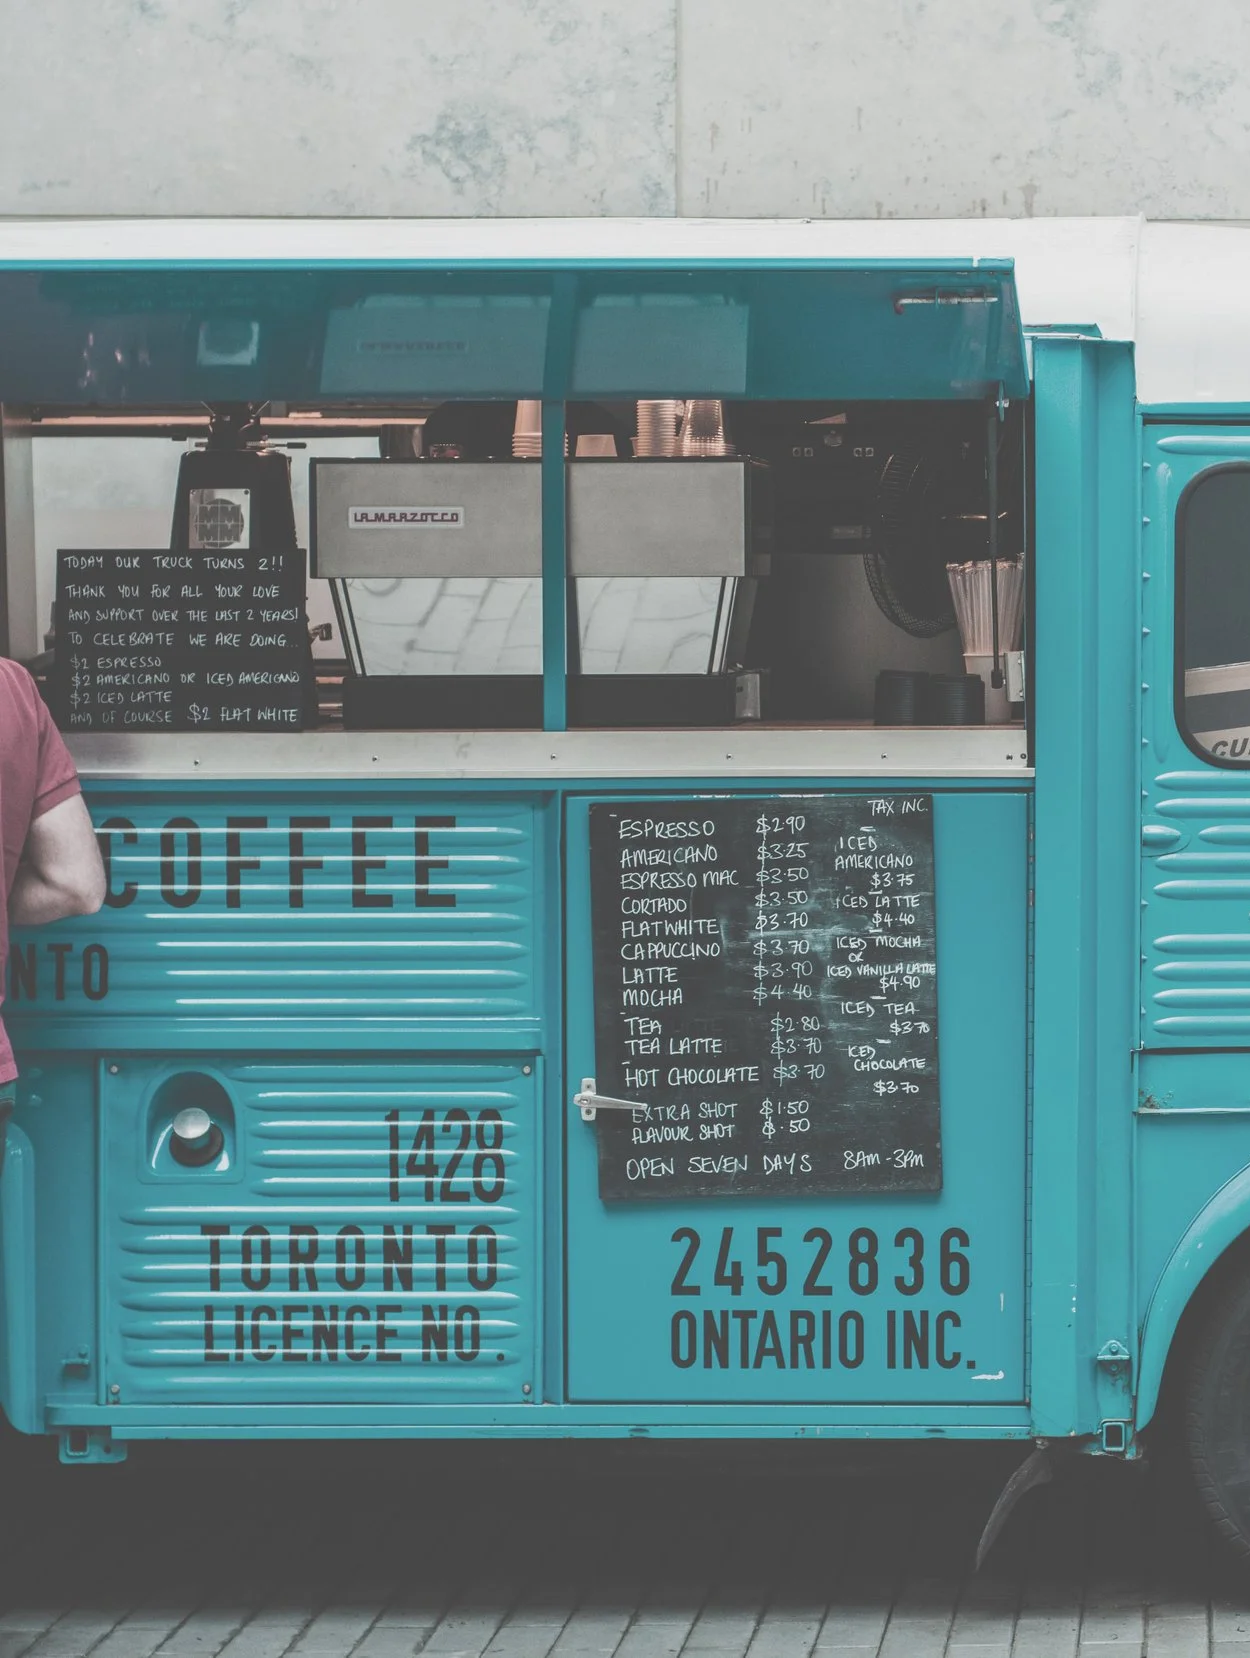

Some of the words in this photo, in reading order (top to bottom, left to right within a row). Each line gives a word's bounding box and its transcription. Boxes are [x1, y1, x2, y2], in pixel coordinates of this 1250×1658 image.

[64, 557, 103, 568] TODAY
[116, 557, 140, 567] OUR
[153, 556, 192, 569] TRUCK
[203, 557, 244, 569] TURNS
[259, 556, 282, 572] 2!!
[66, 585, 105, 597] THANK
[118, 585, 139, 596] YOU
[150, 584, 170, 598] FOR
[181, 584, 202, 597] ALL
[215, 585, 242, 597] YOUR
[253, 585, 279, 597] LOVE
[69, 609, 90, 624] AND
[96, 609, 144, 622] SUPPORT
[152, 610, 178, 621] OVER
[187, 610, 207, 622] THE
[215, 609, 240, 621] LAST
[247, 609, 253, 620] 2
[260, 607, 298, 621] YEARS!
[69, 632, 82, 645] TO
[94, 633, 174, 646] CELEBRATE
[189, 634, 206, 646] WE
[215, 634, 241, 647] ARE
[70, 655, 88, 669] $2
[98, 657, 161, 668] ESPRESSO
[72, 674, 91, 689] $2
[97, 673, 169, 684] AMERICANO
[181, 673, 195, 683] OR
[207, 672, 234, 686] ICED
[239, 672, 299, 684] AMERICANO
[70, 691, 90, 709] $2
[98, 693, 124, 704] ICED
[131, 691, 172, 702] LATTE
[70, 713, 92, 724] AND
[103, 712, 115, 723] OF
[124, 711, 172, 723] COURSE
[187, 703, 211, 723] $2
[221, 708, 251, 721] FLAT
[258, 709, 297, 722] WHITE
[867, 800, 894, 815] TAX
[902, 802, 929, 814] INC.
[619, 821, 715, 838] ESPRESSO
[756, 814, 806, 840] $2.90
[840, 836, 877, 851] ICED
[101, 816, 455, 908] COFFEE
[620, 845, 717, 868] AMERICANO
[757, 839, 809, 865] $3.25
[835, 855, 913, 870] AMERICANO
[620, 871, 696, 890] ESPRESSO
[704, 871, 739, 885] MAC
[757, 865, 809, 886] $3.50
[872, 873, 915, 887] $3.75
[622, 897, 686, 913] CORTADO
[755, 887, 808, 908] $3.50
[836, 895, 868, 908] ICED
[875, 894, 920, 908] LATTE
[755, 909, 808, 934] $3.70
[872, 911, 915, 927] $4.40
[621, 944, 720, 960] CAPPUCCINO
[753, 940, 809, 962] $3.70
[837, 938, 867, 952] ICED
[876, 936, 921, 950] MOCHA
[849, 951, 864, 962] OR
[623, 968, 677, 984] LATTE
[754, 961, 812, 980] $3.90
[828, 964, 851, 977] ICED
[857, 965, 905, 976] VANILLA
[907, 963, 936, 975] LATTE
[880, 975, 920, 992] $4.90
[623, 989, 682, 1006] MOCHA
[753, 983, 812, 1006] $4.40
[841, 1003, 875, 1017] ICED
[883, 1002, 918, 1016] TEA
[625, 1017, 662, 1036] TEA
[771, 1012, 820, 1038] $2.80
[890, 1021, 930, 1036] $3.70
[625, 1039, 660, 1056] TEA
[670, 1038, 722, 1054] LATTE
[771, 1036, 822, 1059] $3.70
[848, 1046, 875, 1058] ICED
[625, 1068, 657, 1087] HOT
[668, 1066, 760, 1085] CHOCOLATE
[773, 1060, 825, 1086] $3.70
[854, 1058, 926, 1071] CHOCOLATE
[873, 1080, 919, 1096] $3.70
[632, 1104, 690, 1123] EXTRA
[699, 1102, 738, 1118] SHOT
[760, 1098, 809, 1119] $1.50
[632, 1126, 693, 1144] FLAVOUR
[699, 1124, 734, 1139] SHOT
[385, 1108, 505, 1203] 1428
[627, 1158, 674, 1180] OPEN
[688, 1155, 748, 1173] SEVEN
[763, 1155, 812, 1172] DAYS
[200, 1225, 497, 1291] TORONTO
[671, 1227, 969, 1296] 2452836
[204, 1305, 402, 1362] LICENCE
[671, 1310, 864, 1369] ONTARIO
[887, 1310, 975, 1369] INC.
